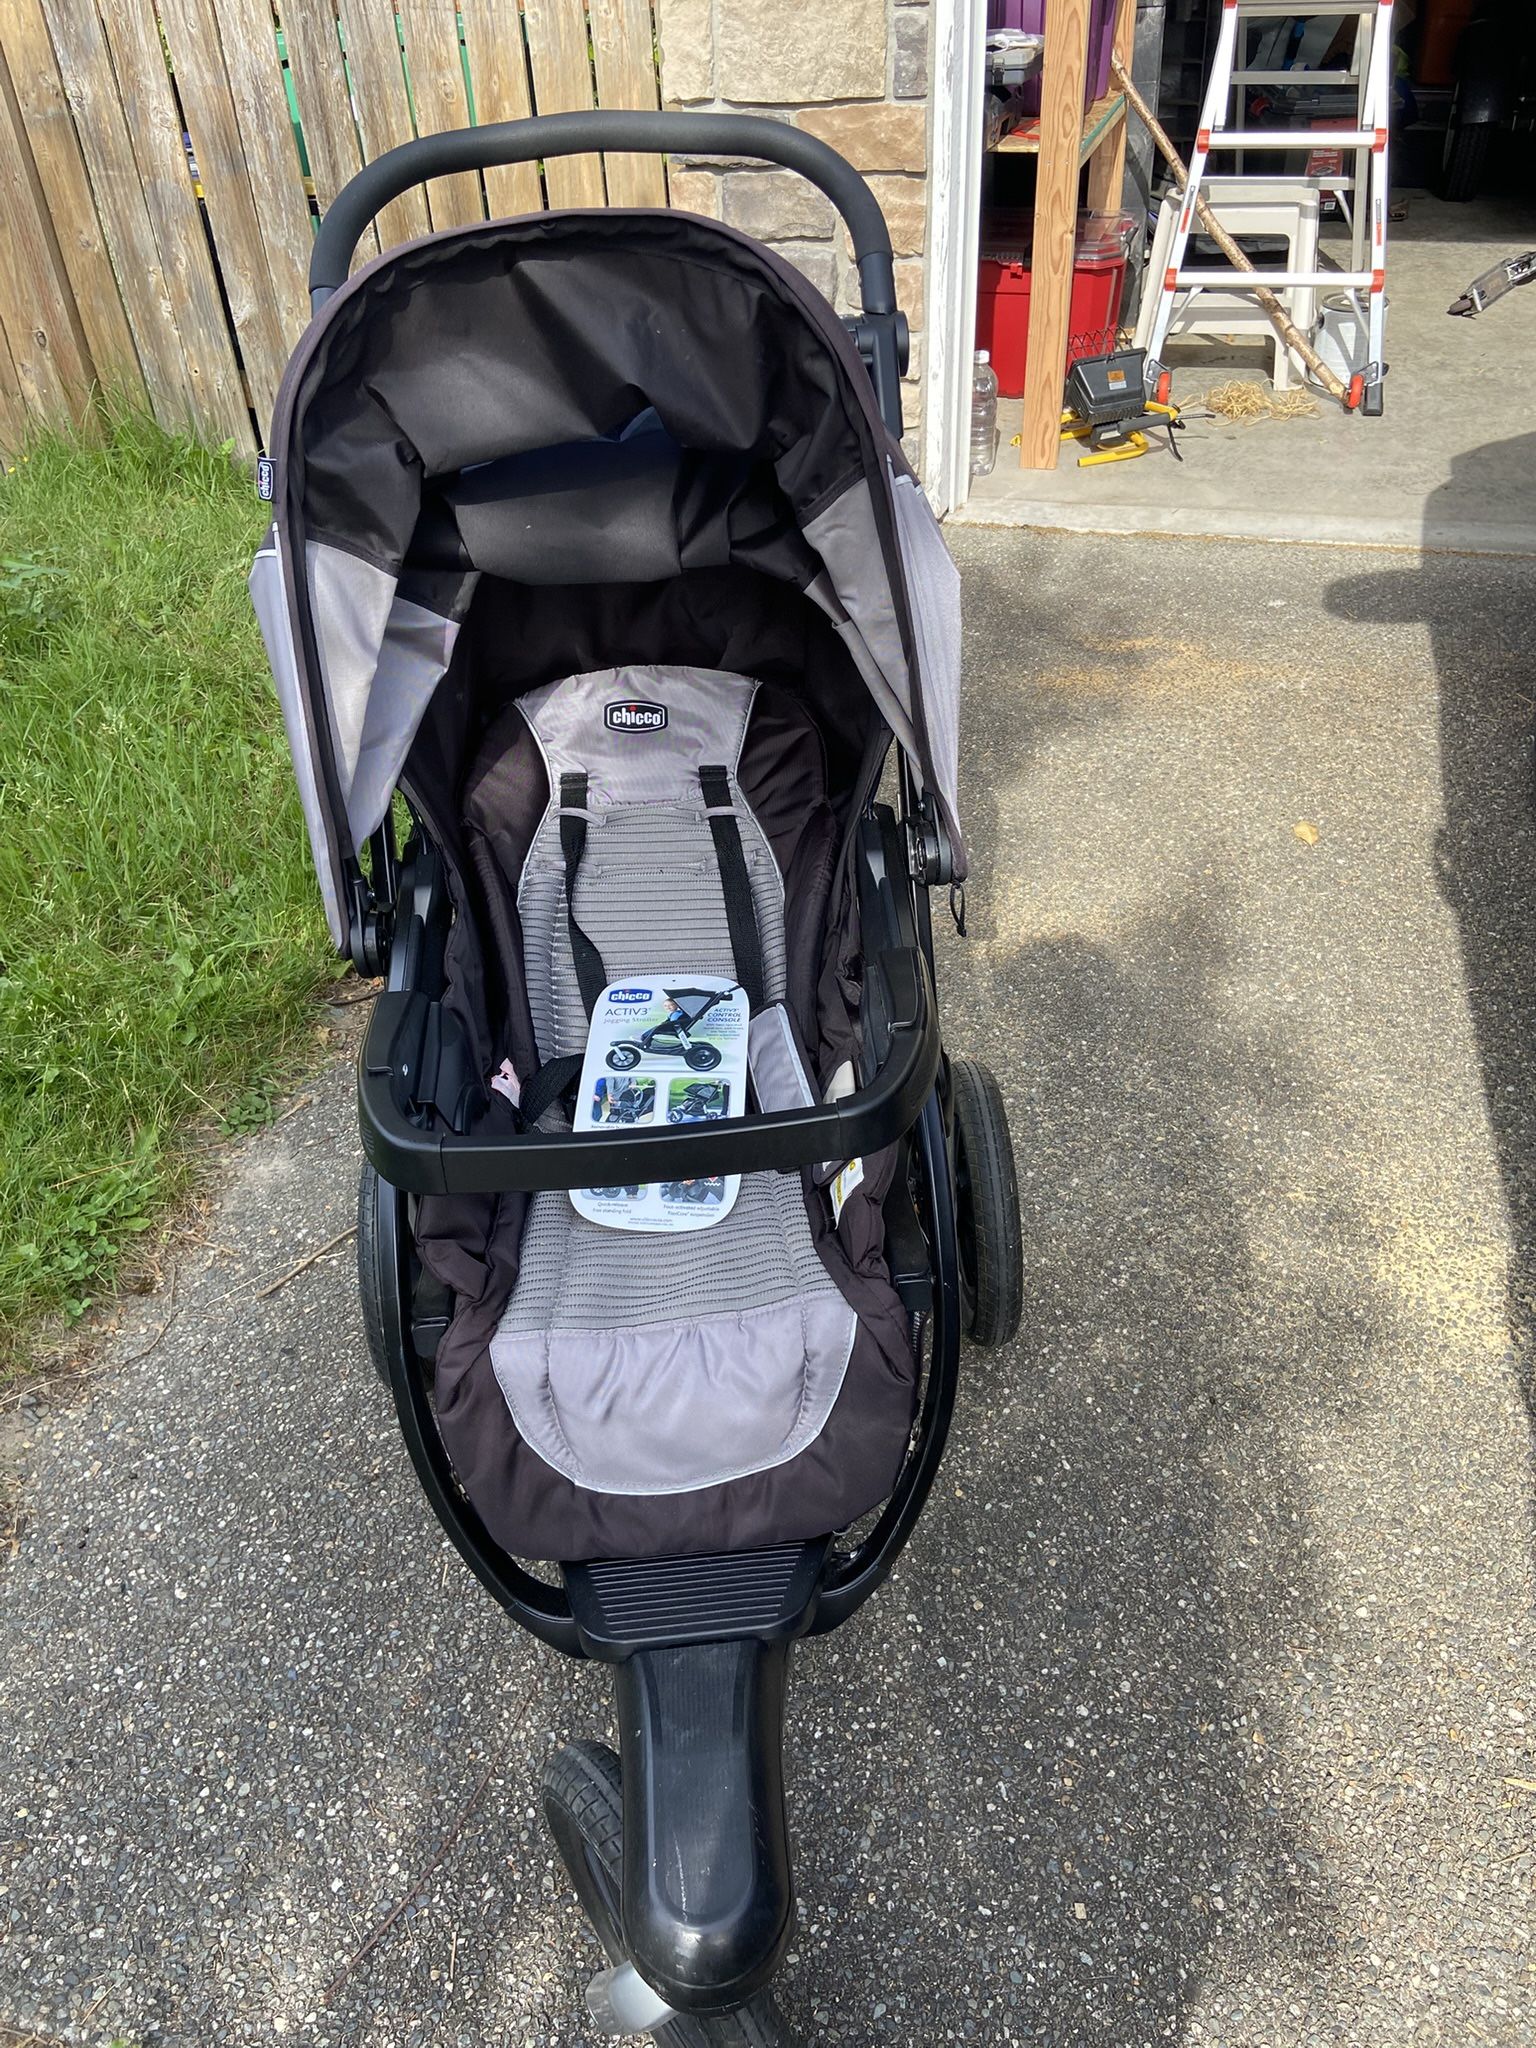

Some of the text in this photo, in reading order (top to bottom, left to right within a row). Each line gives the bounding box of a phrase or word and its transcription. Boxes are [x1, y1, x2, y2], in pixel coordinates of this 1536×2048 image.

[260, 465, 270, 497] chicco
[612, 705, 661, 725] chicco
[611, 990, 650, 1001] chicco
